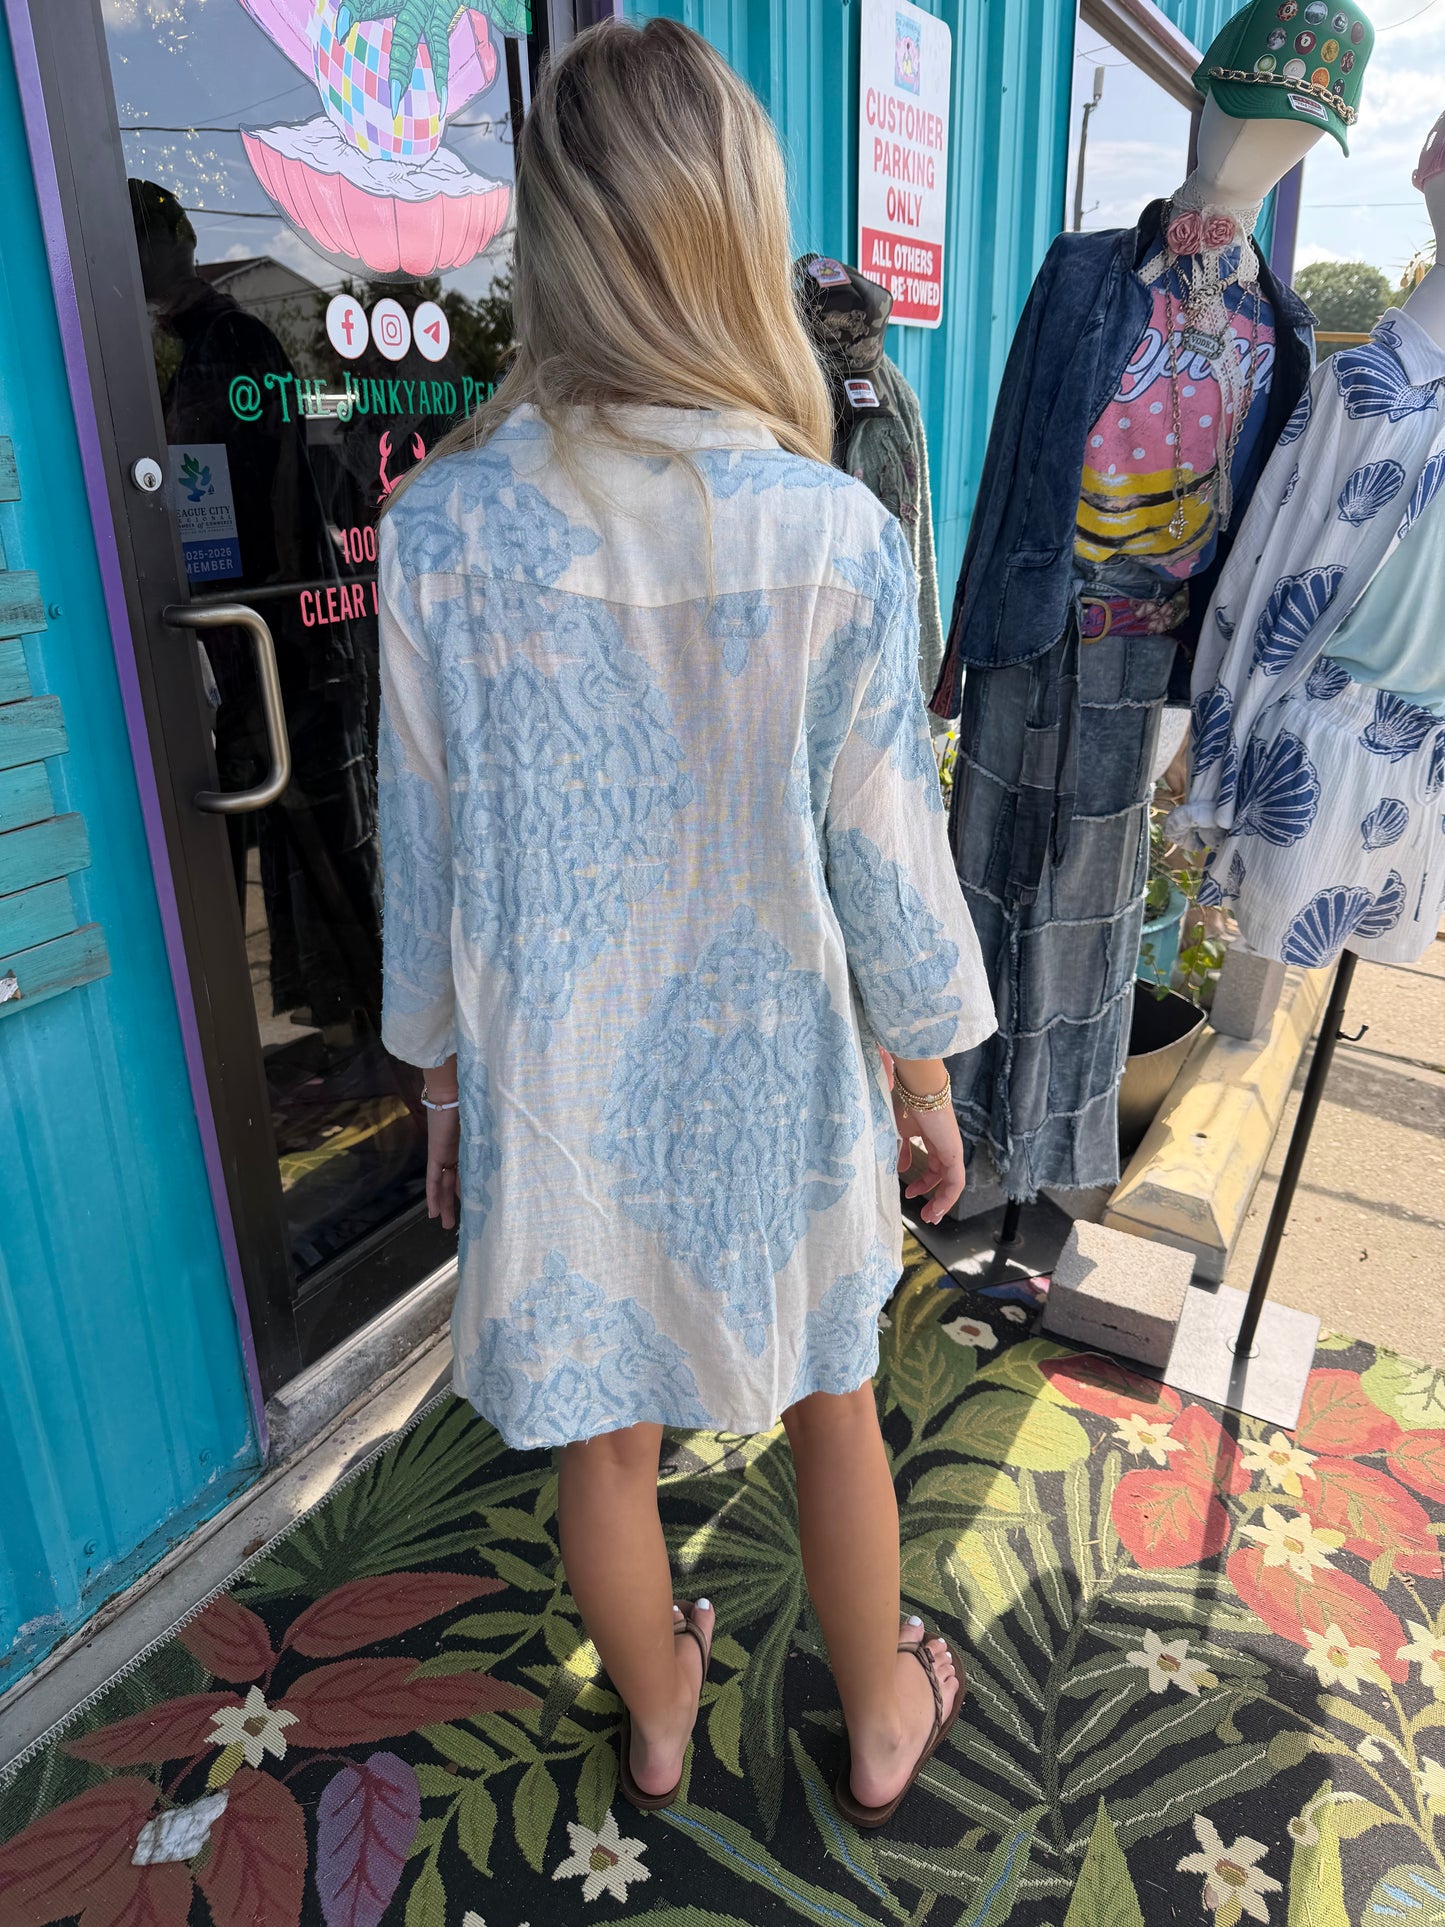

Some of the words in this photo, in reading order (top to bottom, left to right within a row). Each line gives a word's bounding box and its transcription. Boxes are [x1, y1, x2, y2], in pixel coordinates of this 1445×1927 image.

[866, 87, 943, 151] CUSTOMER
[874, 136, 934, 189] PARKING
[886, 186, 922, 227] ONLY
[872, 239, 892, 268] ALL
[894, 244, 933, 276] OTHERS
[890, 275, 905, 302] BE
[906, 278, 940, 306] TOWED
[1191, 335, 1216, 351] VODKA
[336, 371, 457, 423] JUNKYARD
[461, 376, 502, 419] PEA
[177, 507, 206, 518] EAGUE
[209, 505, 230, 515] CITY
[178, 515, 232, 523] EGIONAL
[184, 547, 232, 561] 025-2026
[340, 526, 380, 564] 100
[300, 583, 367, 627] CLEAR
